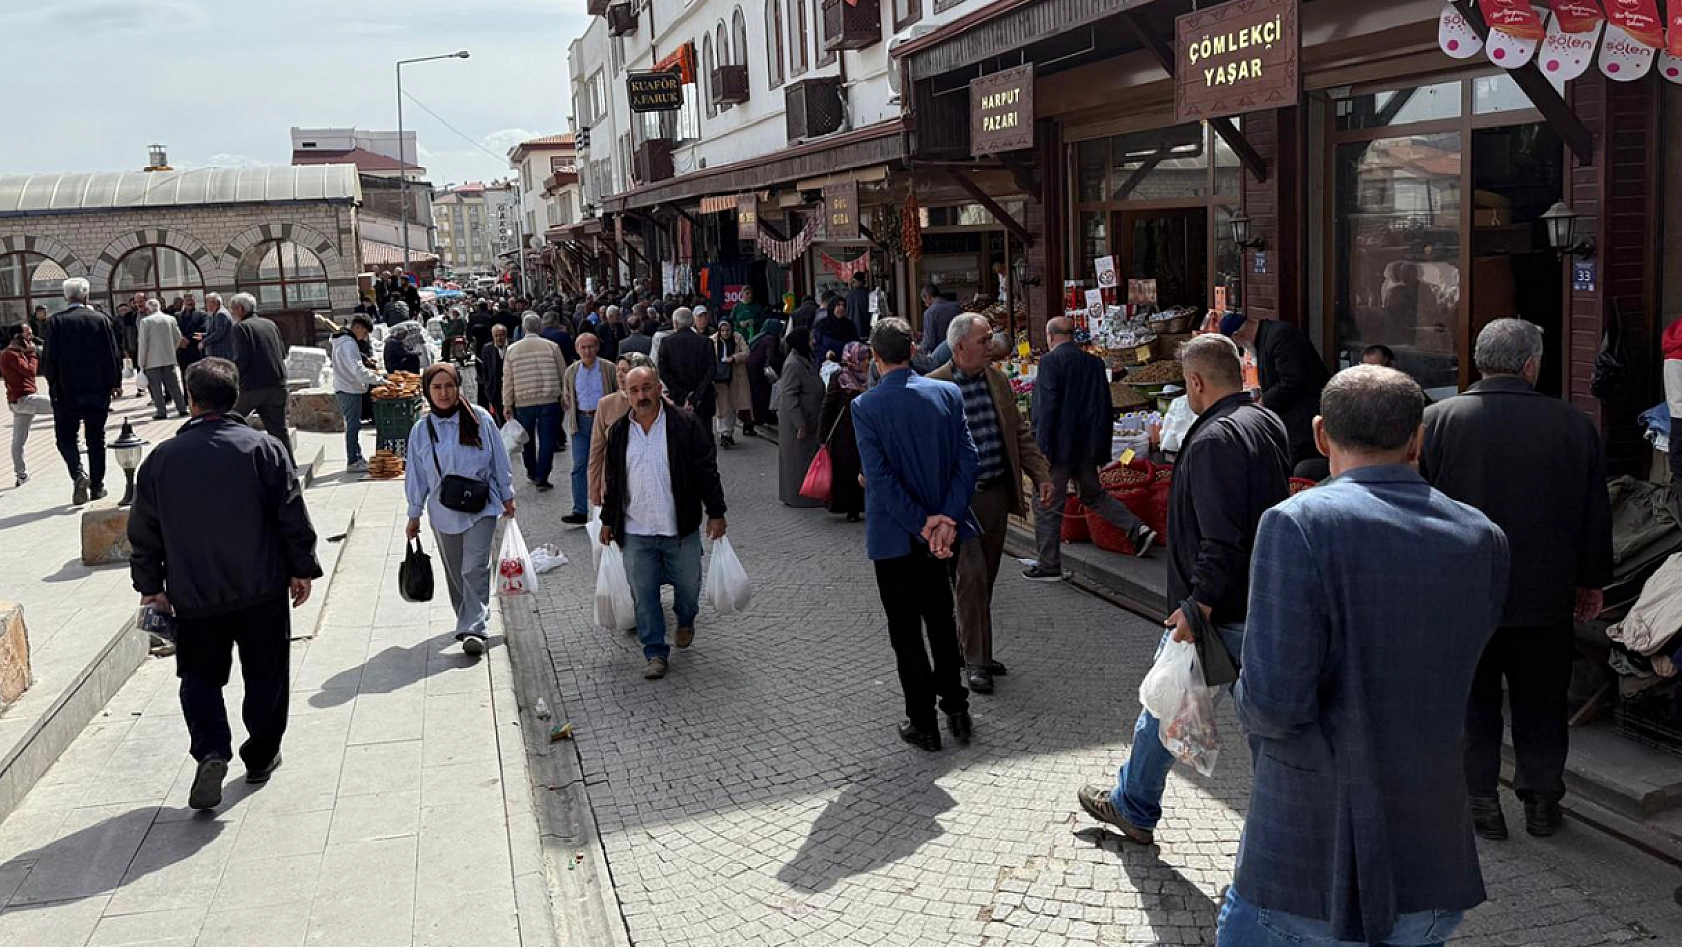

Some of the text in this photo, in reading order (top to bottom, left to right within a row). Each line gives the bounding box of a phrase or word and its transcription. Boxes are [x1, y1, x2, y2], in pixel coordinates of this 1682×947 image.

[1189, 14, 1281, 65] ÇÖMLEKÇİ
[1547, 34, 1592, 50] şölen
[1605, 39, 1651, 56] şölen
[1203, 58, 1262, 87] YAŞAR
[631, 78, 678, 92] KUAFÖR
[981, 88, 1020, 110] HARPUT
[983, 111, 1018, 132] PAZARI
[1577, 270, 1591, 281] 33
